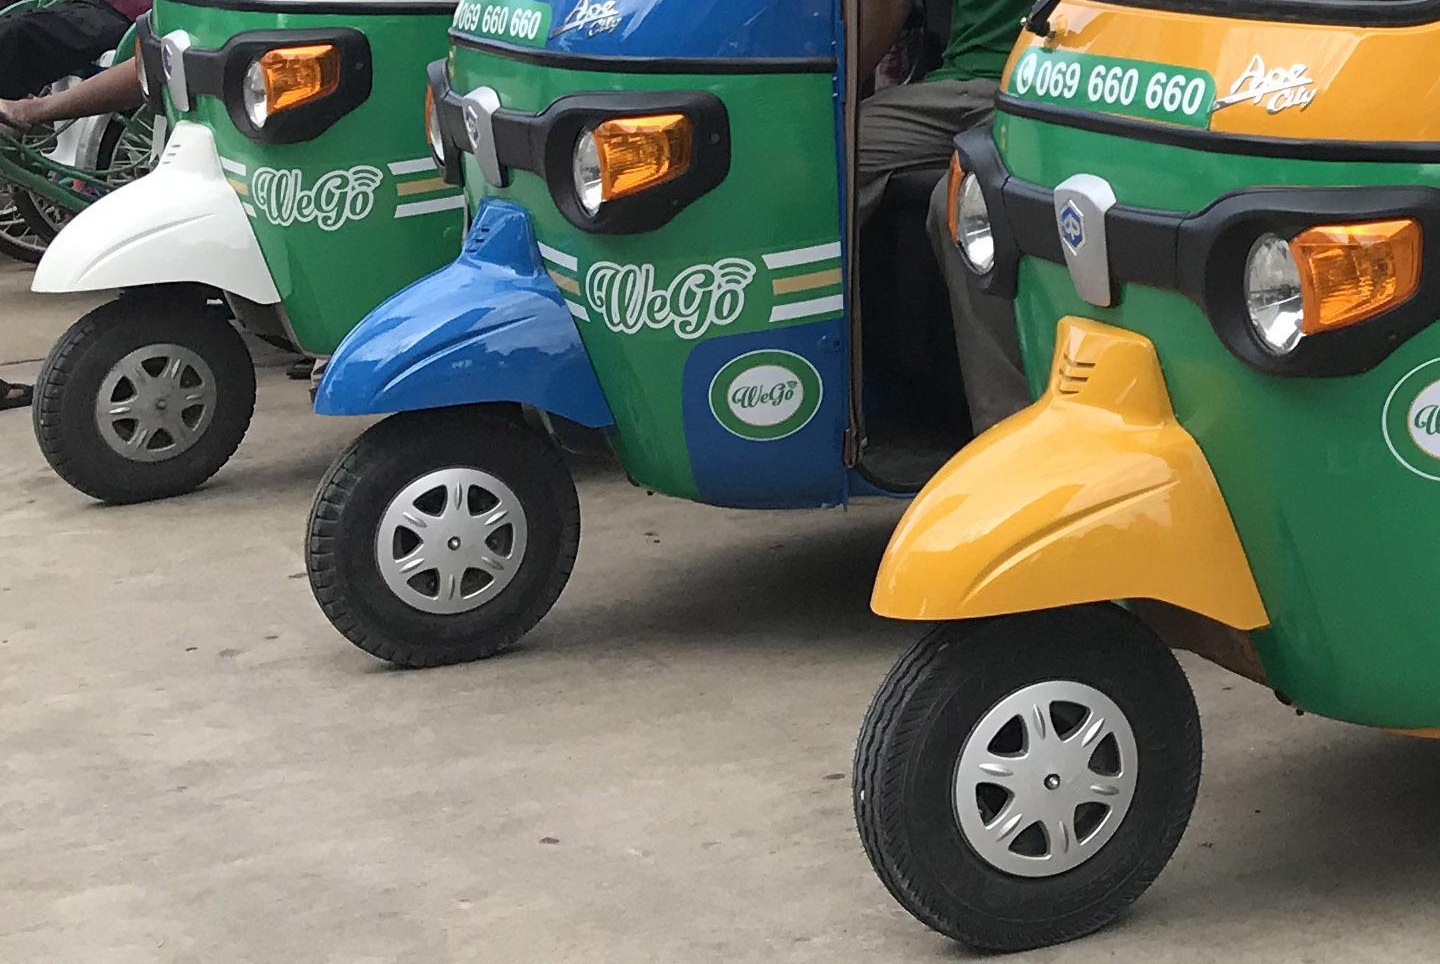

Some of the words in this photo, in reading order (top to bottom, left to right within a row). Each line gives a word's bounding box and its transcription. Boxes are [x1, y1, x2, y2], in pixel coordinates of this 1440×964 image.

[458, 2, 482, 32] 069
[482, 4, 509, 35] 660
[510, 7, 542, 40] 660
[1036, 60, 1081, 99] 069
[1087, 66, 1139, 106] 660
[1145, 72, 1206, 115] 660
[1221, 53, 1313, 105] Ape
[1267, 88, 1317, 114] City
[252, 166, 380, 231] WeGo
[586, 260, 750, 340] WeGo
[732, 382, 796, 409] WeGo
